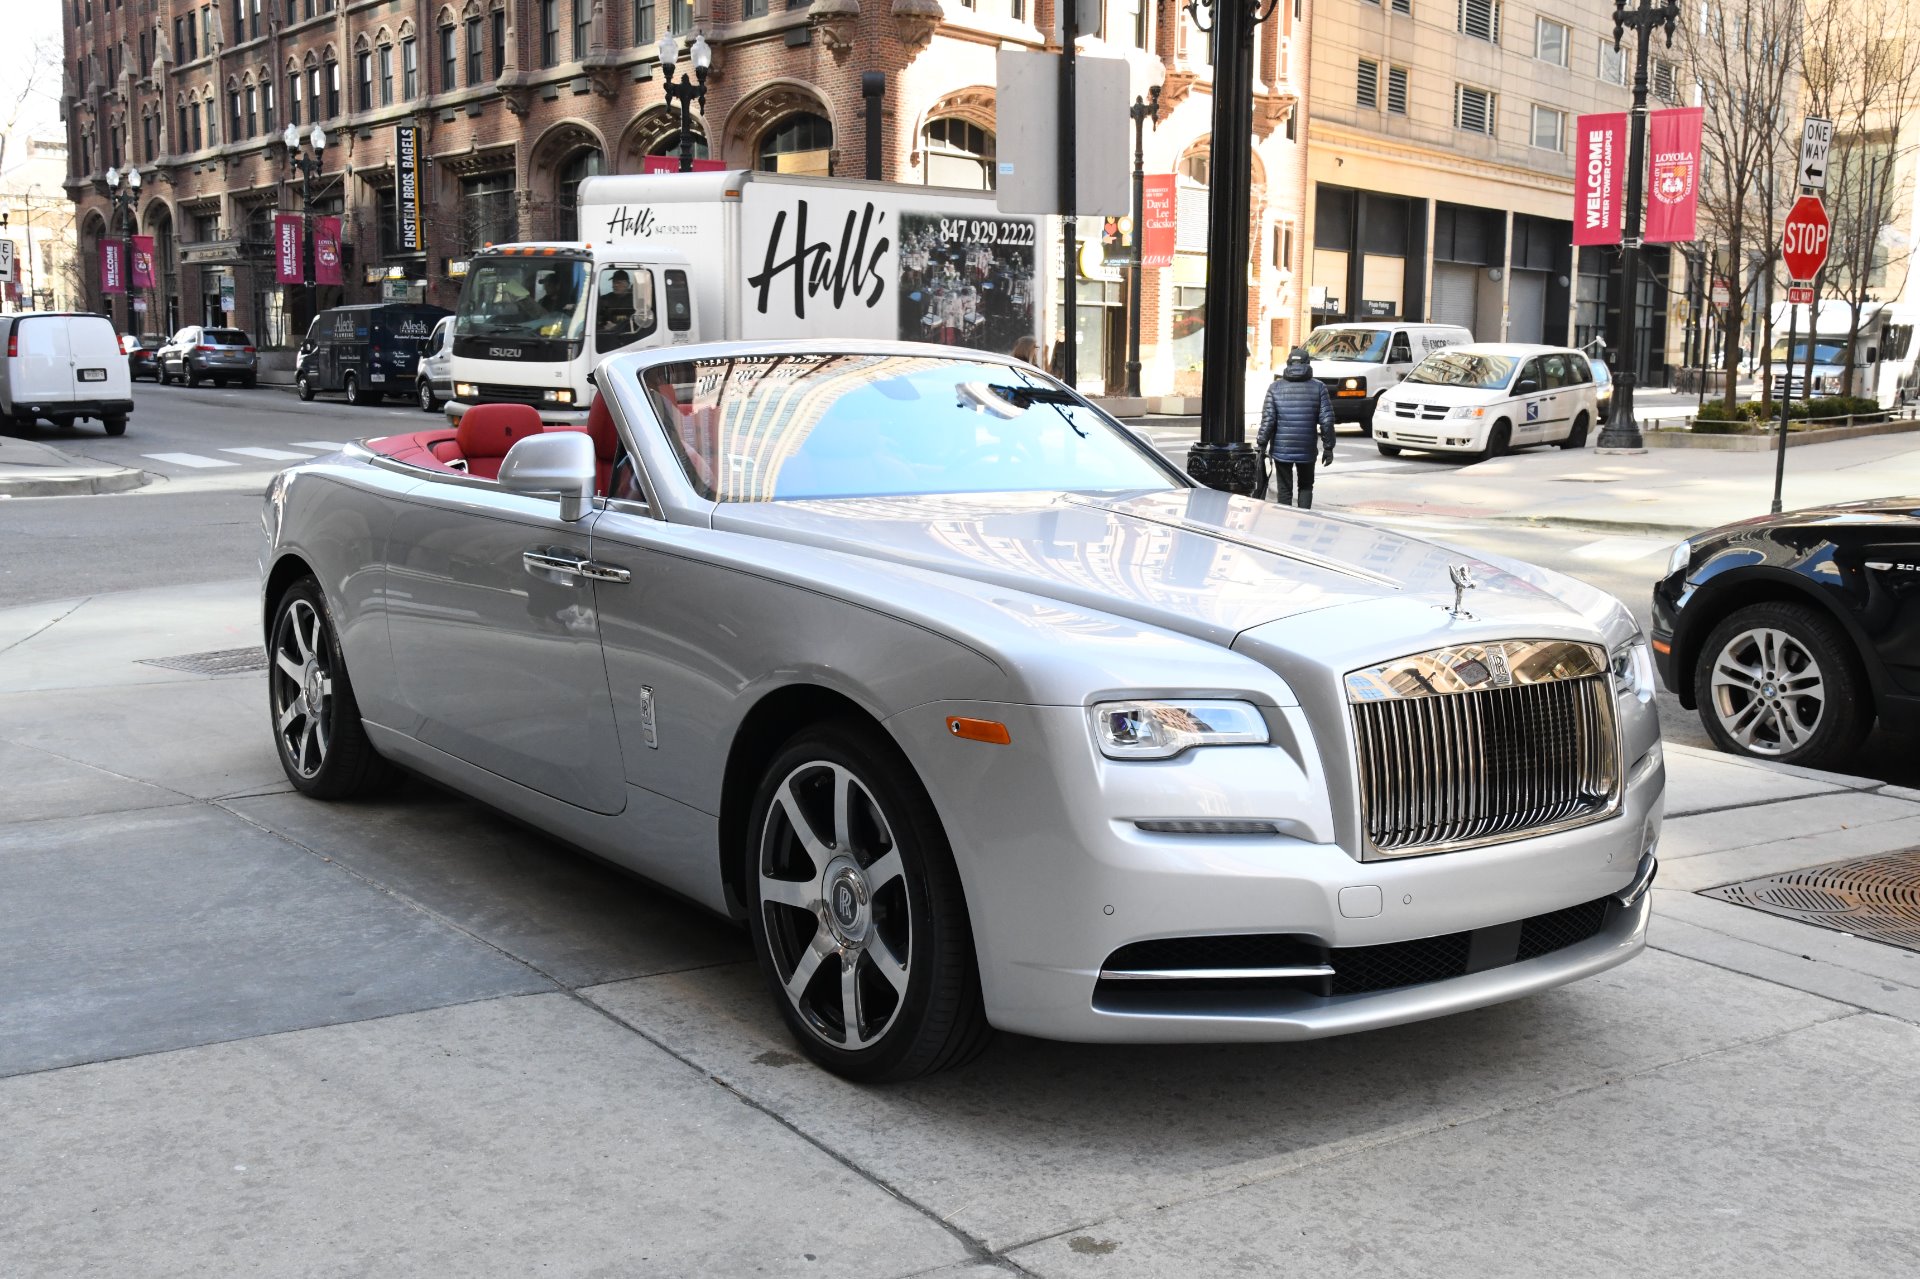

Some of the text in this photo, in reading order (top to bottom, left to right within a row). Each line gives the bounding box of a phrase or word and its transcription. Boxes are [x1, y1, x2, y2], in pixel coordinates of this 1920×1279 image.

[1807, 123, 1828, 142] ONE
[1655, 152, 1694, 163] LOYOLA
[1804, 143, 1827, 160] WAY
[401, 129, 416, 248] EINSTEIN BROS. BAGELS
[1586, 130, 1604, 229] WELCOME
[1602, 130, 1613, 229] WATER TOWER CAMPUS
[1146, 199, 1169, 209] David
[1156, 209, 1170, 218] Lee
[607, 206, 655, 237] Hall's
[1146, 219, 1175, 229] Csicsko
[939, 218, 1035, 246] 847.929.2222
[1785, 222, 1827, 255] STOP
[282, 223, 292, 276] WELCOME
[106, 246, 114, 287] WELCOME
[747, 199, 890, 320] Hall's
[1142, 255, 1172, 265] LUMA
[1790, 291, 1812, 302] ALL WAY
[334, 313, 354, 332] Aleck
[401, 320, 426, 331] Aleck
[489, 347, 522, 358] ISUZU
